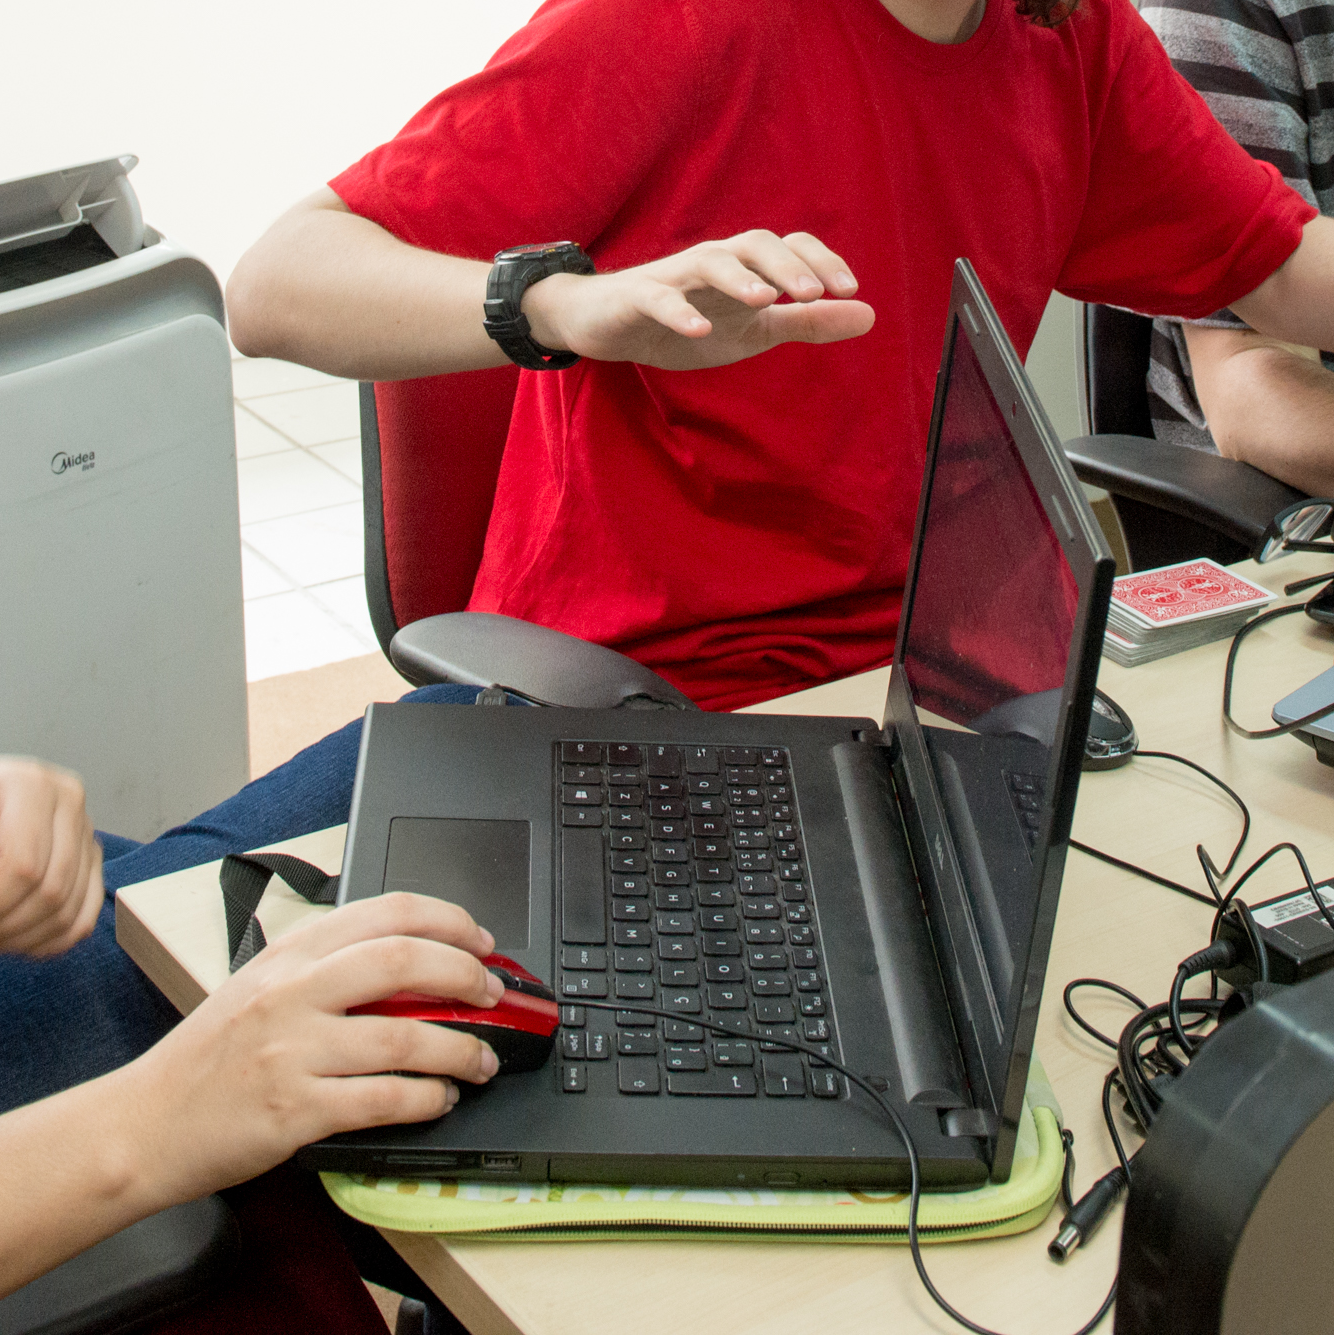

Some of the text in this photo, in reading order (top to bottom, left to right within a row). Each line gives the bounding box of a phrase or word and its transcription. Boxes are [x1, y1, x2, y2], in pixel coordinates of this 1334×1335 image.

[53, 451, 95, 472] Midea
[702, 801, 711, 809] W
[719, 965, 729, 973] O
